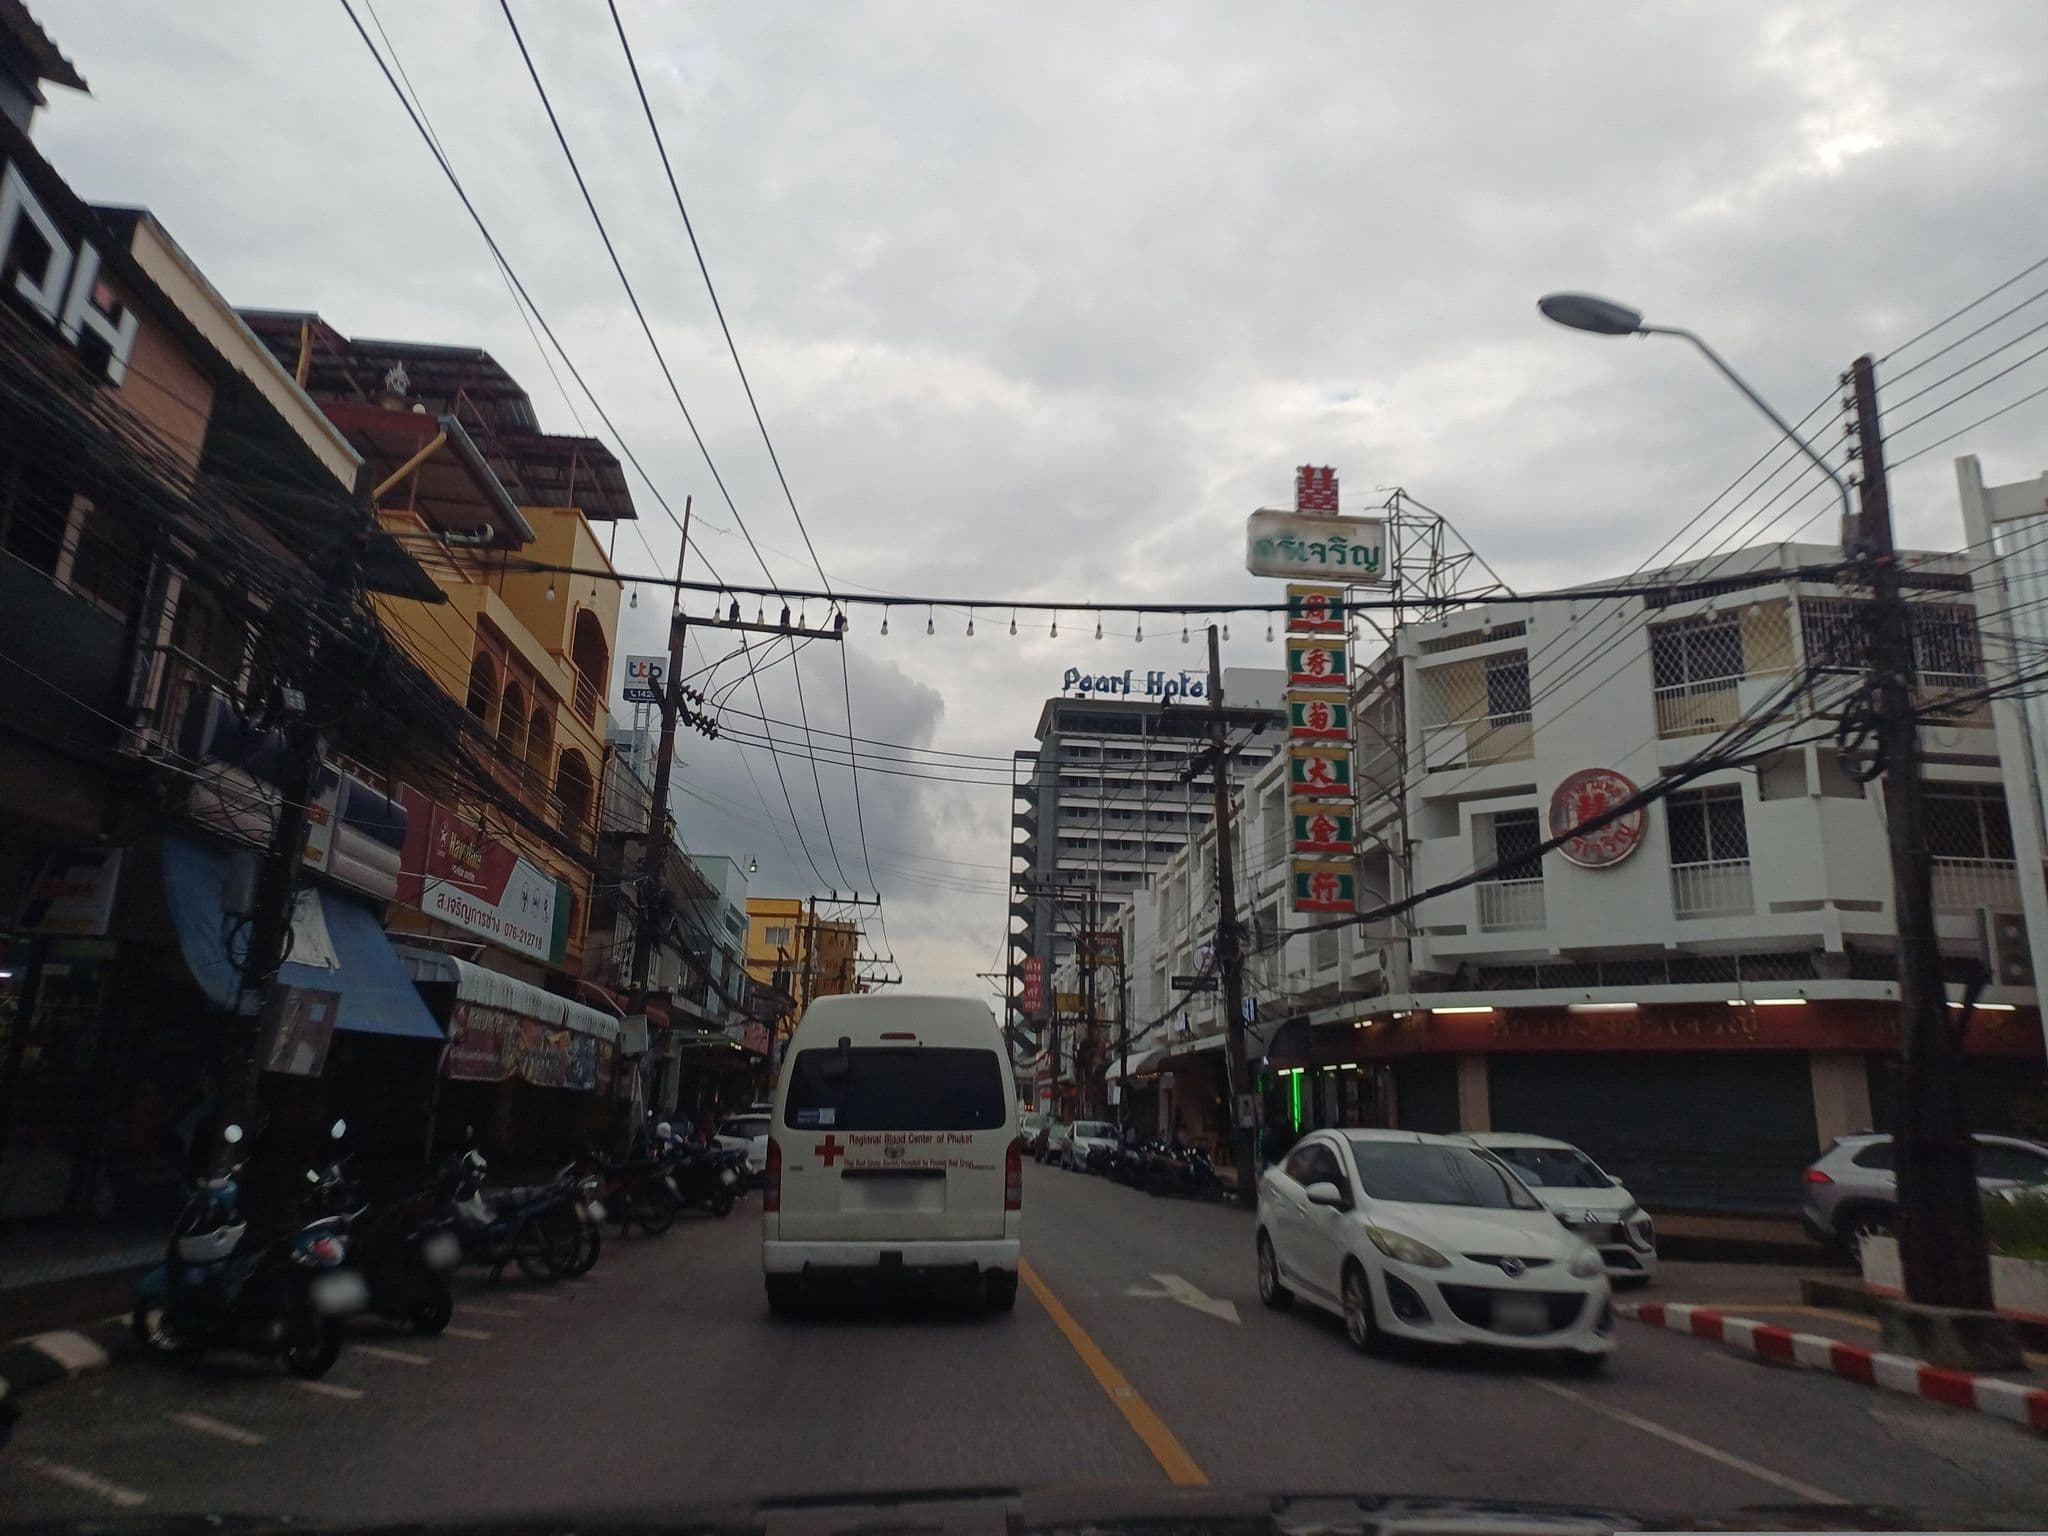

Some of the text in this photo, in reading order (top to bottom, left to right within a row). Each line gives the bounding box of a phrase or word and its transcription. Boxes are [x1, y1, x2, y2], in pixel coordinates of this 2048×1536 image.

[628, 660, 662, 679] ttb
[1062, 667, 1132, 695] Pearl
[637, 689, 655, 698] 142
[504, 922, 544, 950] 076-212718
[848, 1133, 974, 1147] Regional Blood Center of Phuket
